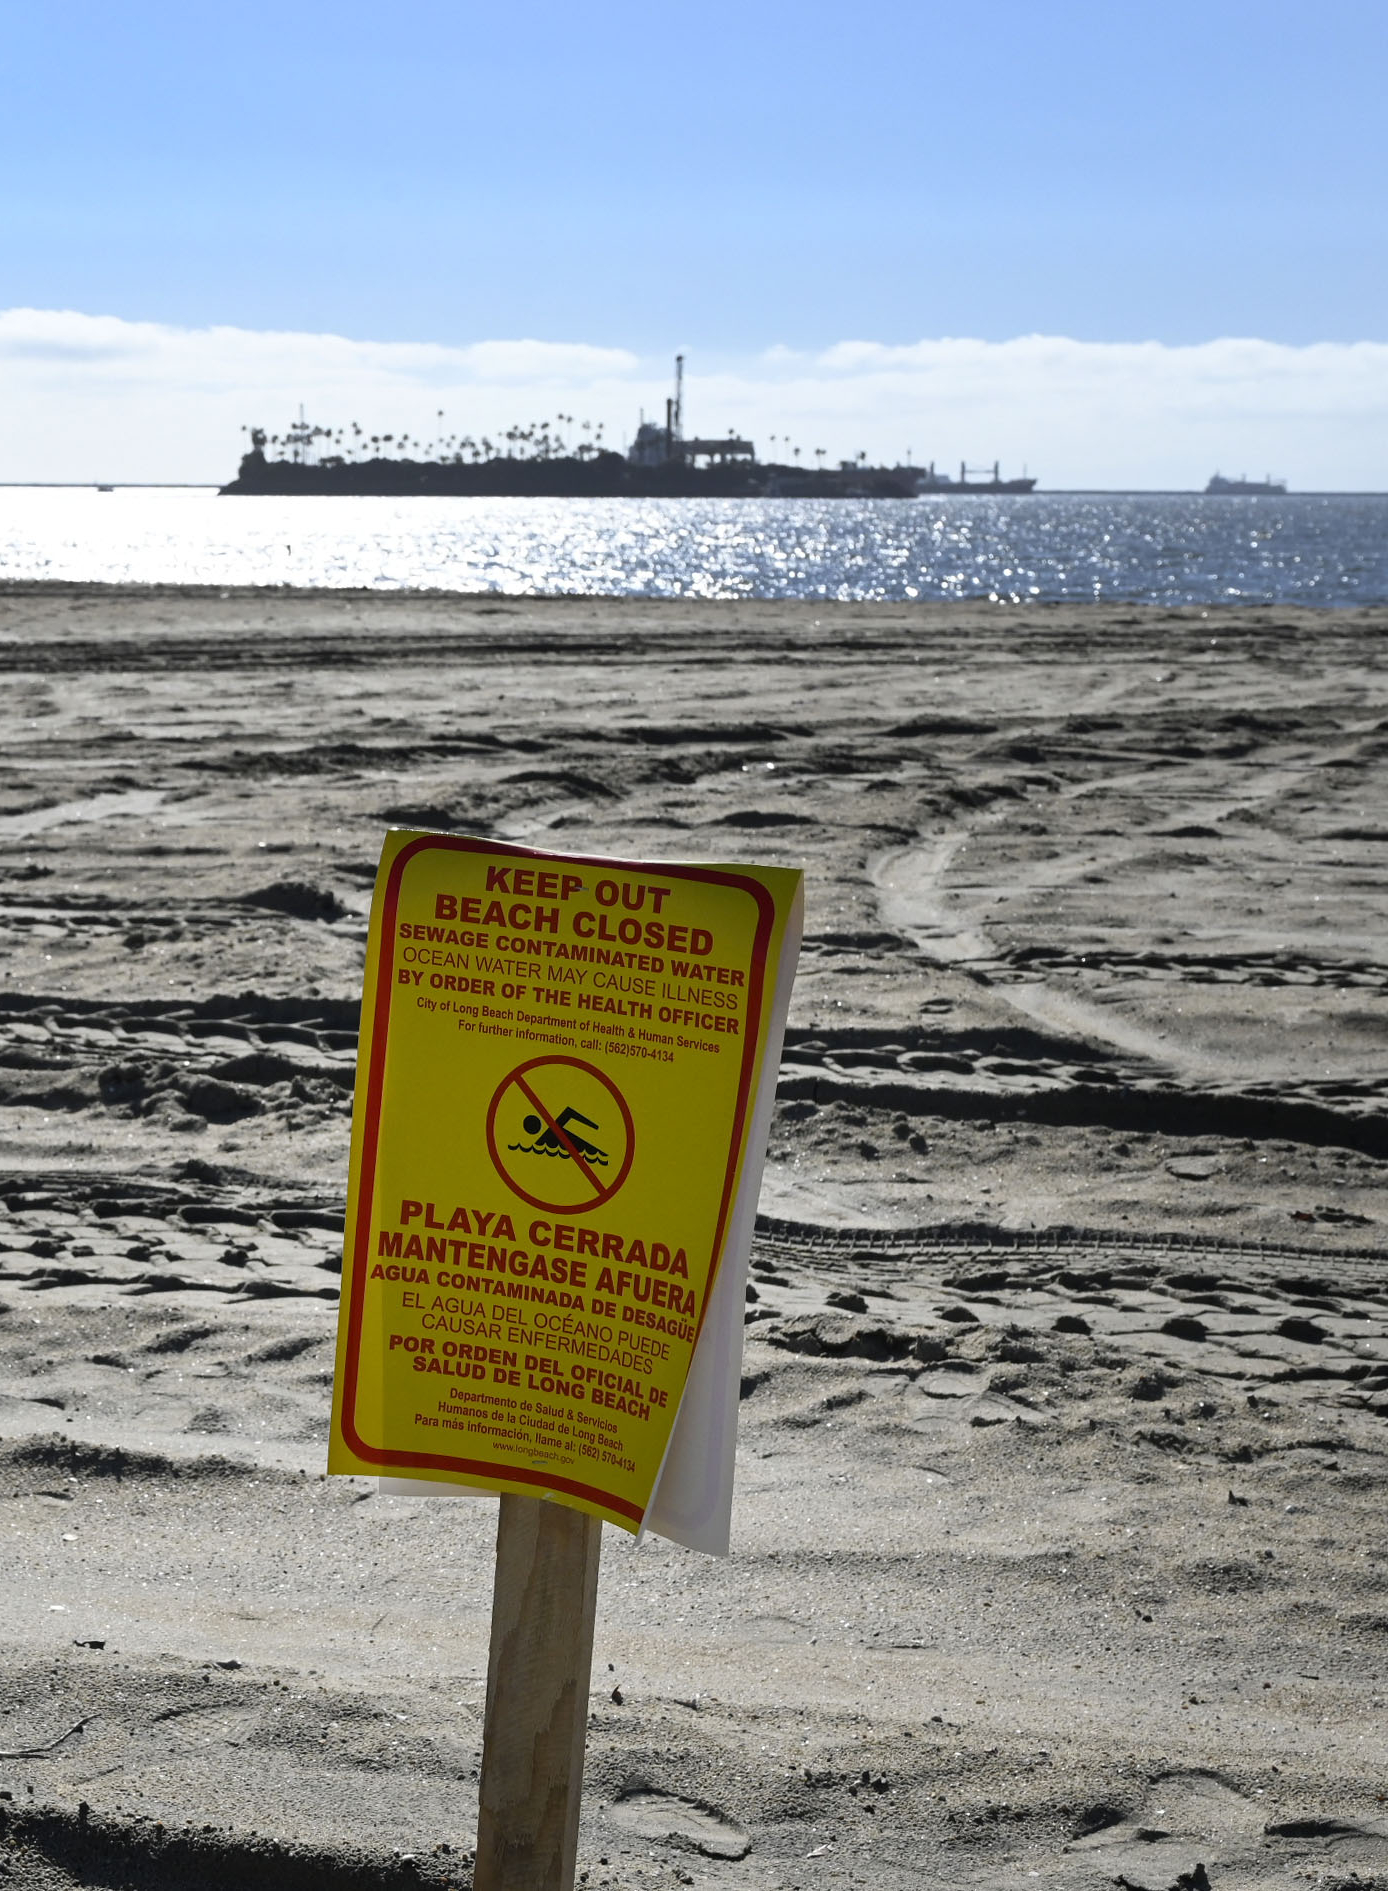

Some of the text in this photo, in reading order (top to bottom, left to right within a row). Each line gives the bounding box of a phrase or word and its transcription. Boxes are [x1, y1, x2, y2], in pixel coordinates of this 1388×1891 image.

[485, 865, 672, 914] KEEP OUT
[399, 923, 745, 987] SEWAGE CONTAMINATED WATER
[434, 893, 714, 956] BEACH CLOSED
[398, 969, 739, 1035] BY ORDER OF THE HEALTH OFFICER
[403, 947, 738, 1010] OCEAN WATER MAY CAUSE ILLNESS
[416, 996, 720, 1054] City of Long Beach Department of Health & Human Services
[458, 1019, 674, 1063] For further information, call: (562)570-4134
[400, 1200, 689, 1280] PLAYA CERRADA
[370, 1264, 696, 1344] AGUA CONTAMINADA DE DESAGÜE
[377, 1231, 696, 1319] MANTENGASE AFUERA
[402, 1292, 671, 1361] EL AGUA DEL OCÉANO PUEDE
[422, 1313, 653, 1375] CAUSAR ENFERMEDADES
[389, 1334, 669, 1408] POR ORDEN DEL OFICIAL DE
[412, 1355, 651, 1422] SALUD DE LONG BEACH
[437, 1400, 623, 1452] Humanos de la Ciudad de Long Beach
[449, 1387, 618, 1434] Departmento de Salud & Servicios
[414, 1413, 636, 1473] Para más información, llame al: (562) 570-4134
[492, 1441, 575, 1465] www.longbeach.gov
